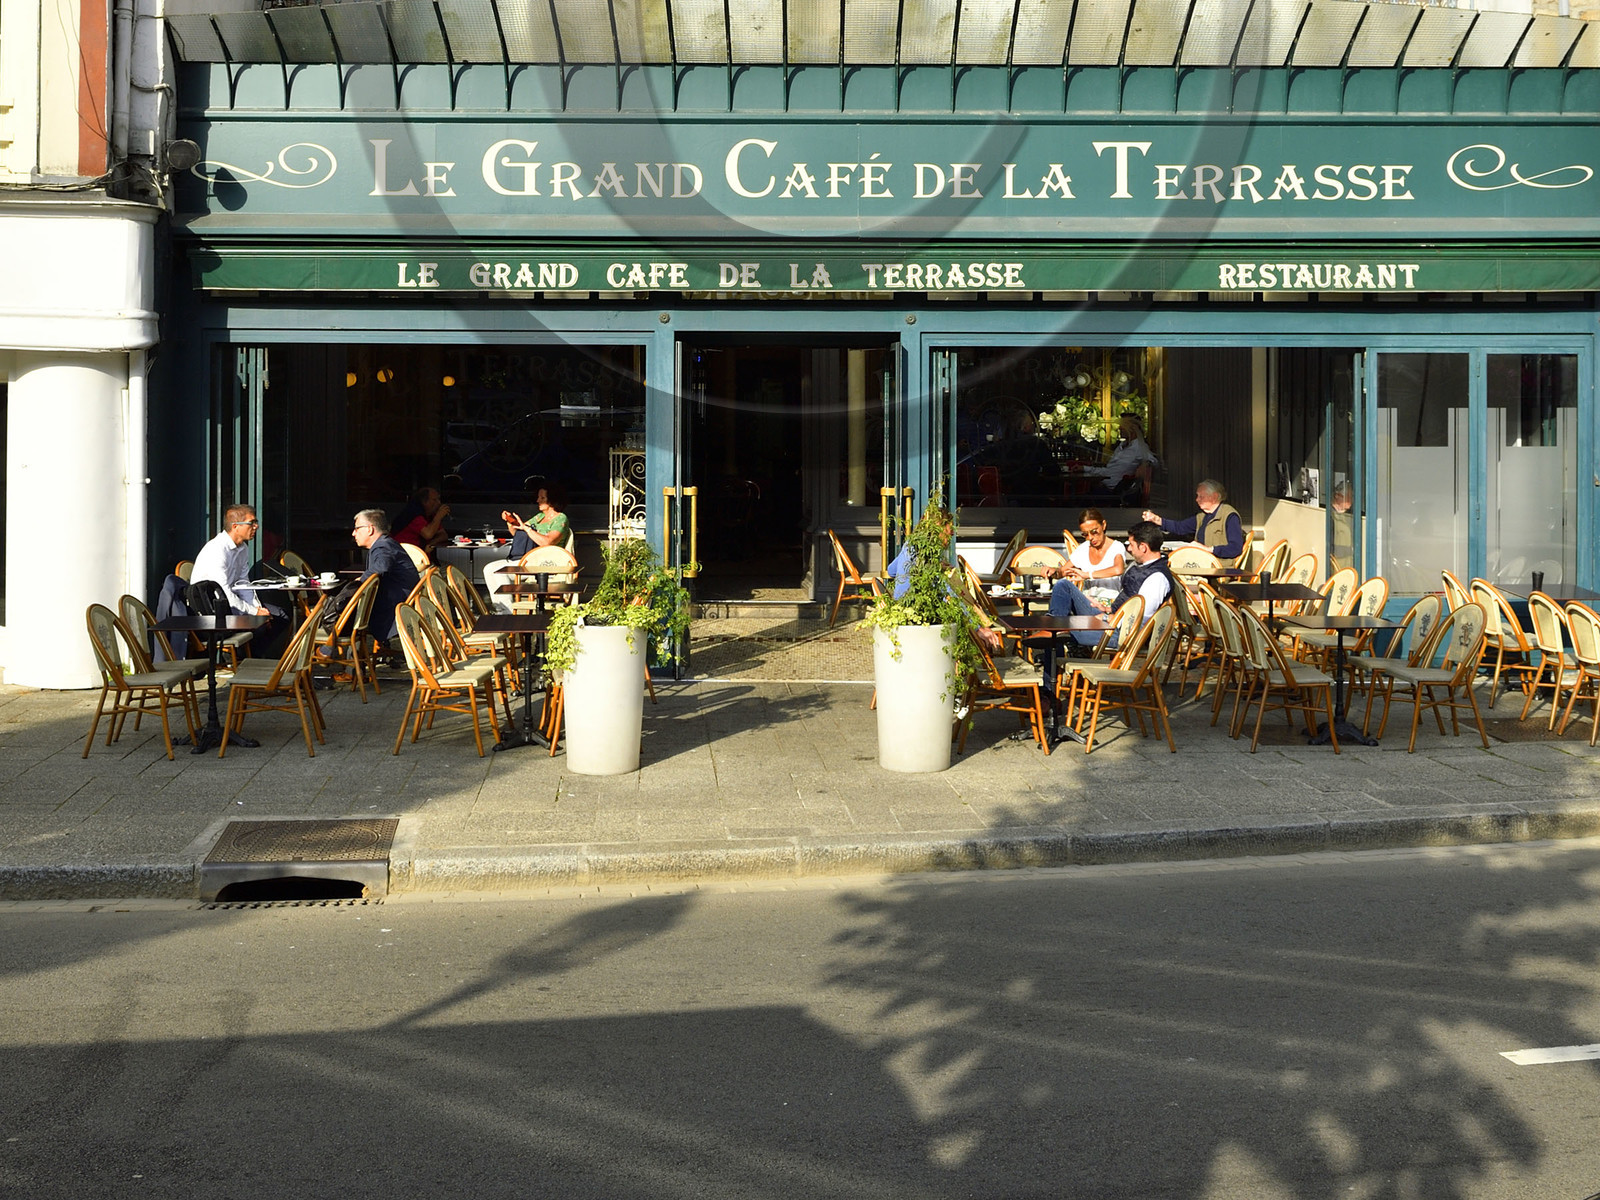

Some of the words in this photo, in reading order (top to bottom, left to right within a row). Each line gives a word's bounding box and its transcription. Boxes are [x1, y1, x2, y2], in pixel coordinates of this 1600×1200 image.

[368, 138, 457, 198] LE
[481, 137, 703, 202] GRAND
[723, 137, 894, 199] CAFÉ
[912, 163, 984, 199] DE
[1001, 164, 1077, 199] LA
[1091, 141, 1416, 204] TERRASSE
[396, 262, 440, 288] LE
[468, 262, 579, 290] GRAND
[606, 262, 690, 288] CAFE
[718, 263, 762, 288] DE
[788, 263, 834, 288] LA
[861, 263, 1026, 289] TERRASSE
[1218, 263, 1421, 290] RESTAURANT
